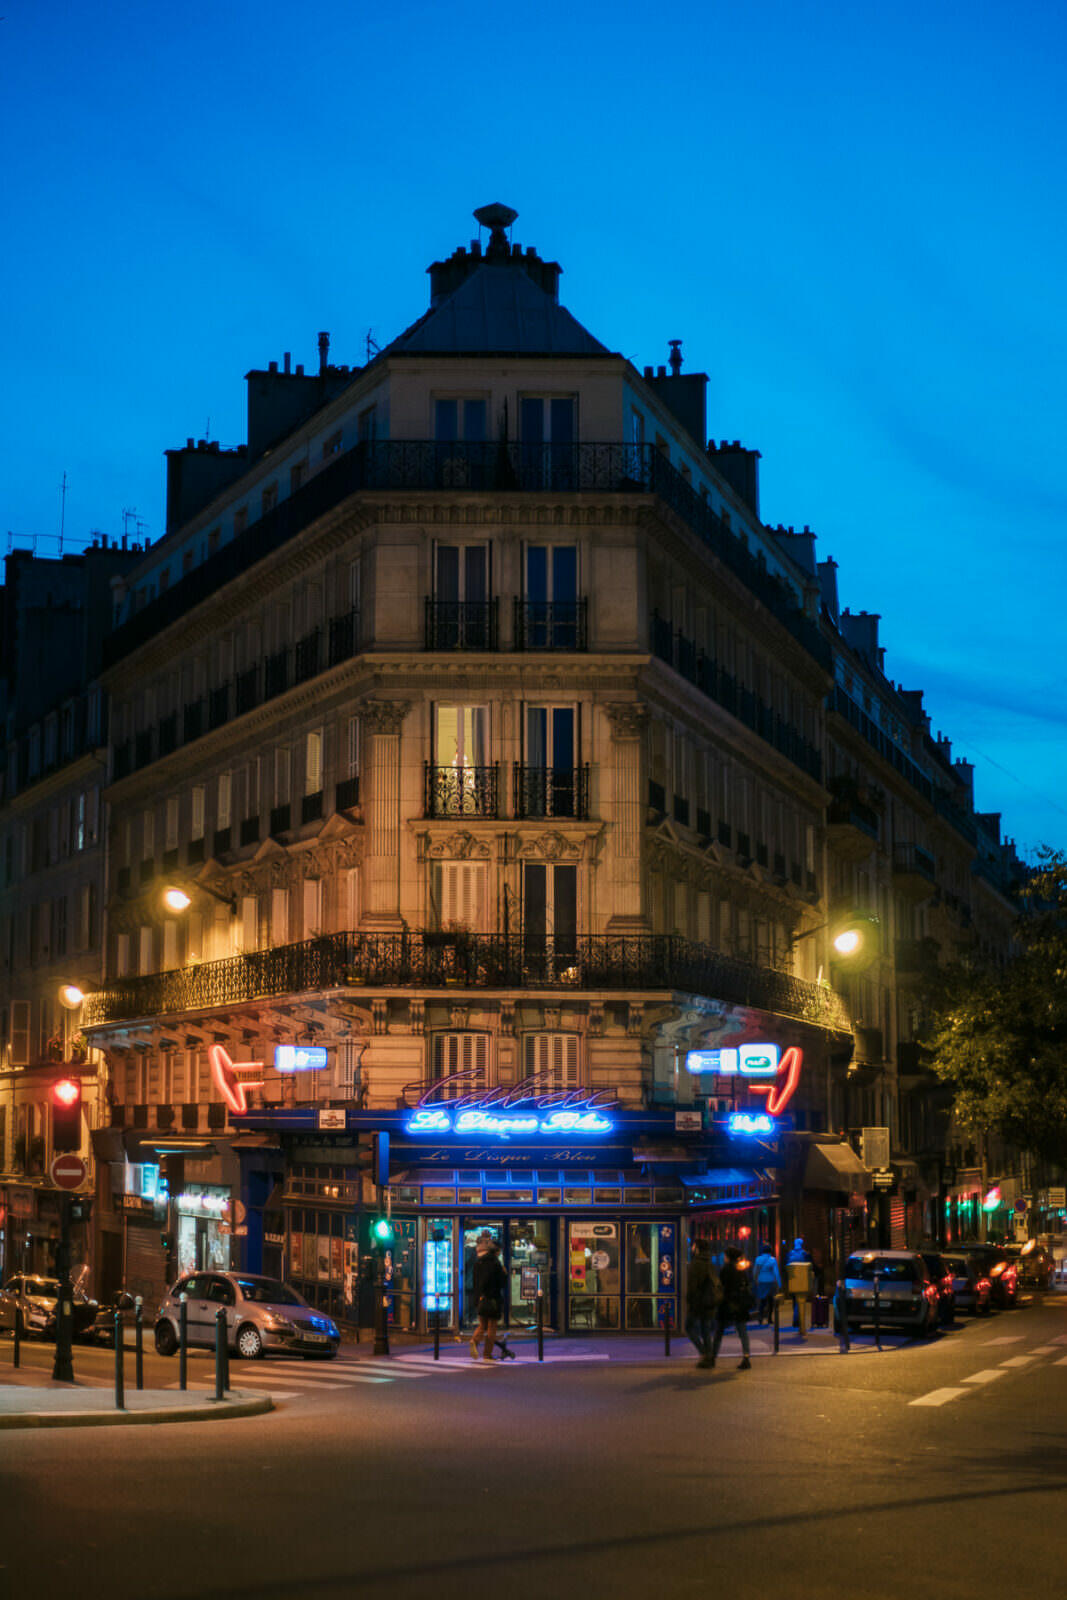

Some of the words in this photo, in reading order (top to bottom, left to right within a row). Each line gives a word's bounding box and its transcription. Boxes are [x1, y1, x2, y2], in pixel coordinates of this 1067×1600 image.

[419, 1149, 450, 1161] Le
[463, 1149, 532, 1164] Disque
[543, 1149, 597, 1161] Bleu
